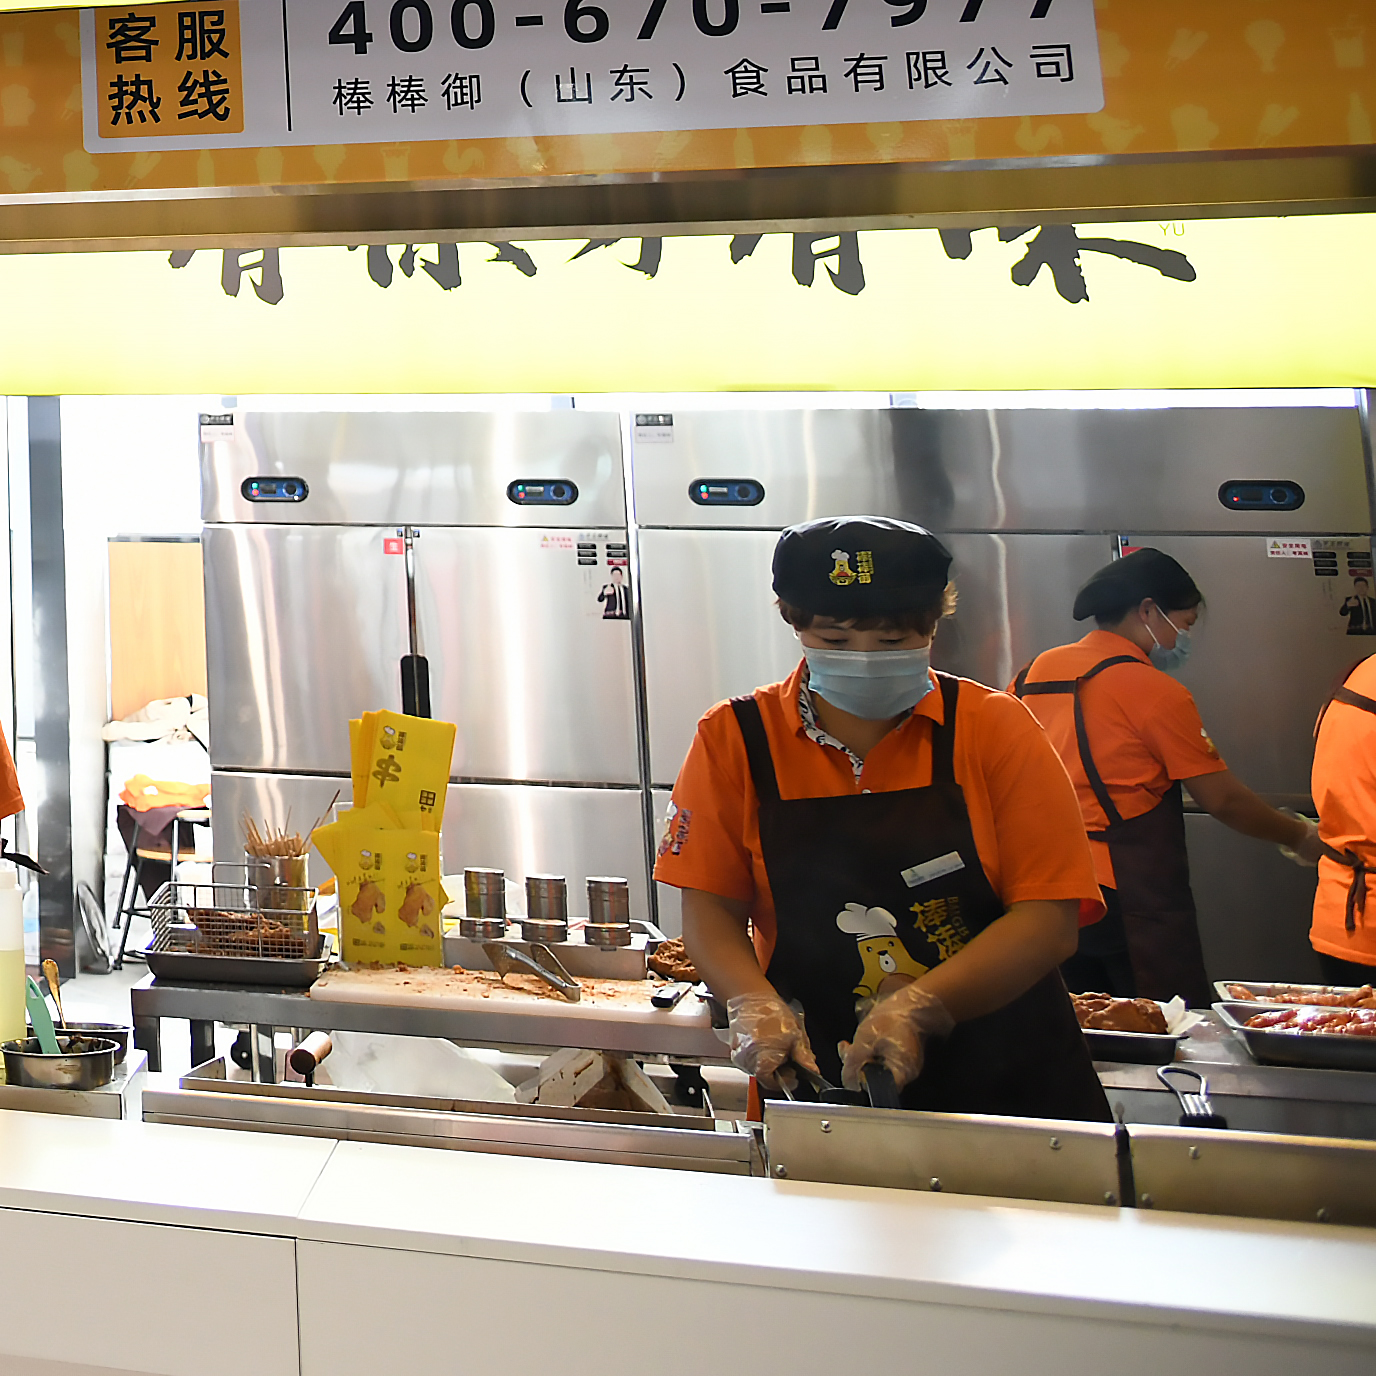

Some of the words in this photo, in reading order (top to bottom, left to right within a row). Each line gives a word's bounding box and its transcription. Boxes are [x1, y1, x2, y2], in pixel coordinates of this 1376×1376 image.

[105, 9, 231, 64] 客服
[106, 69, 232, 127] 热线
[332, 43, 1076, 118] 棒棒御（山东）食品有限公司
